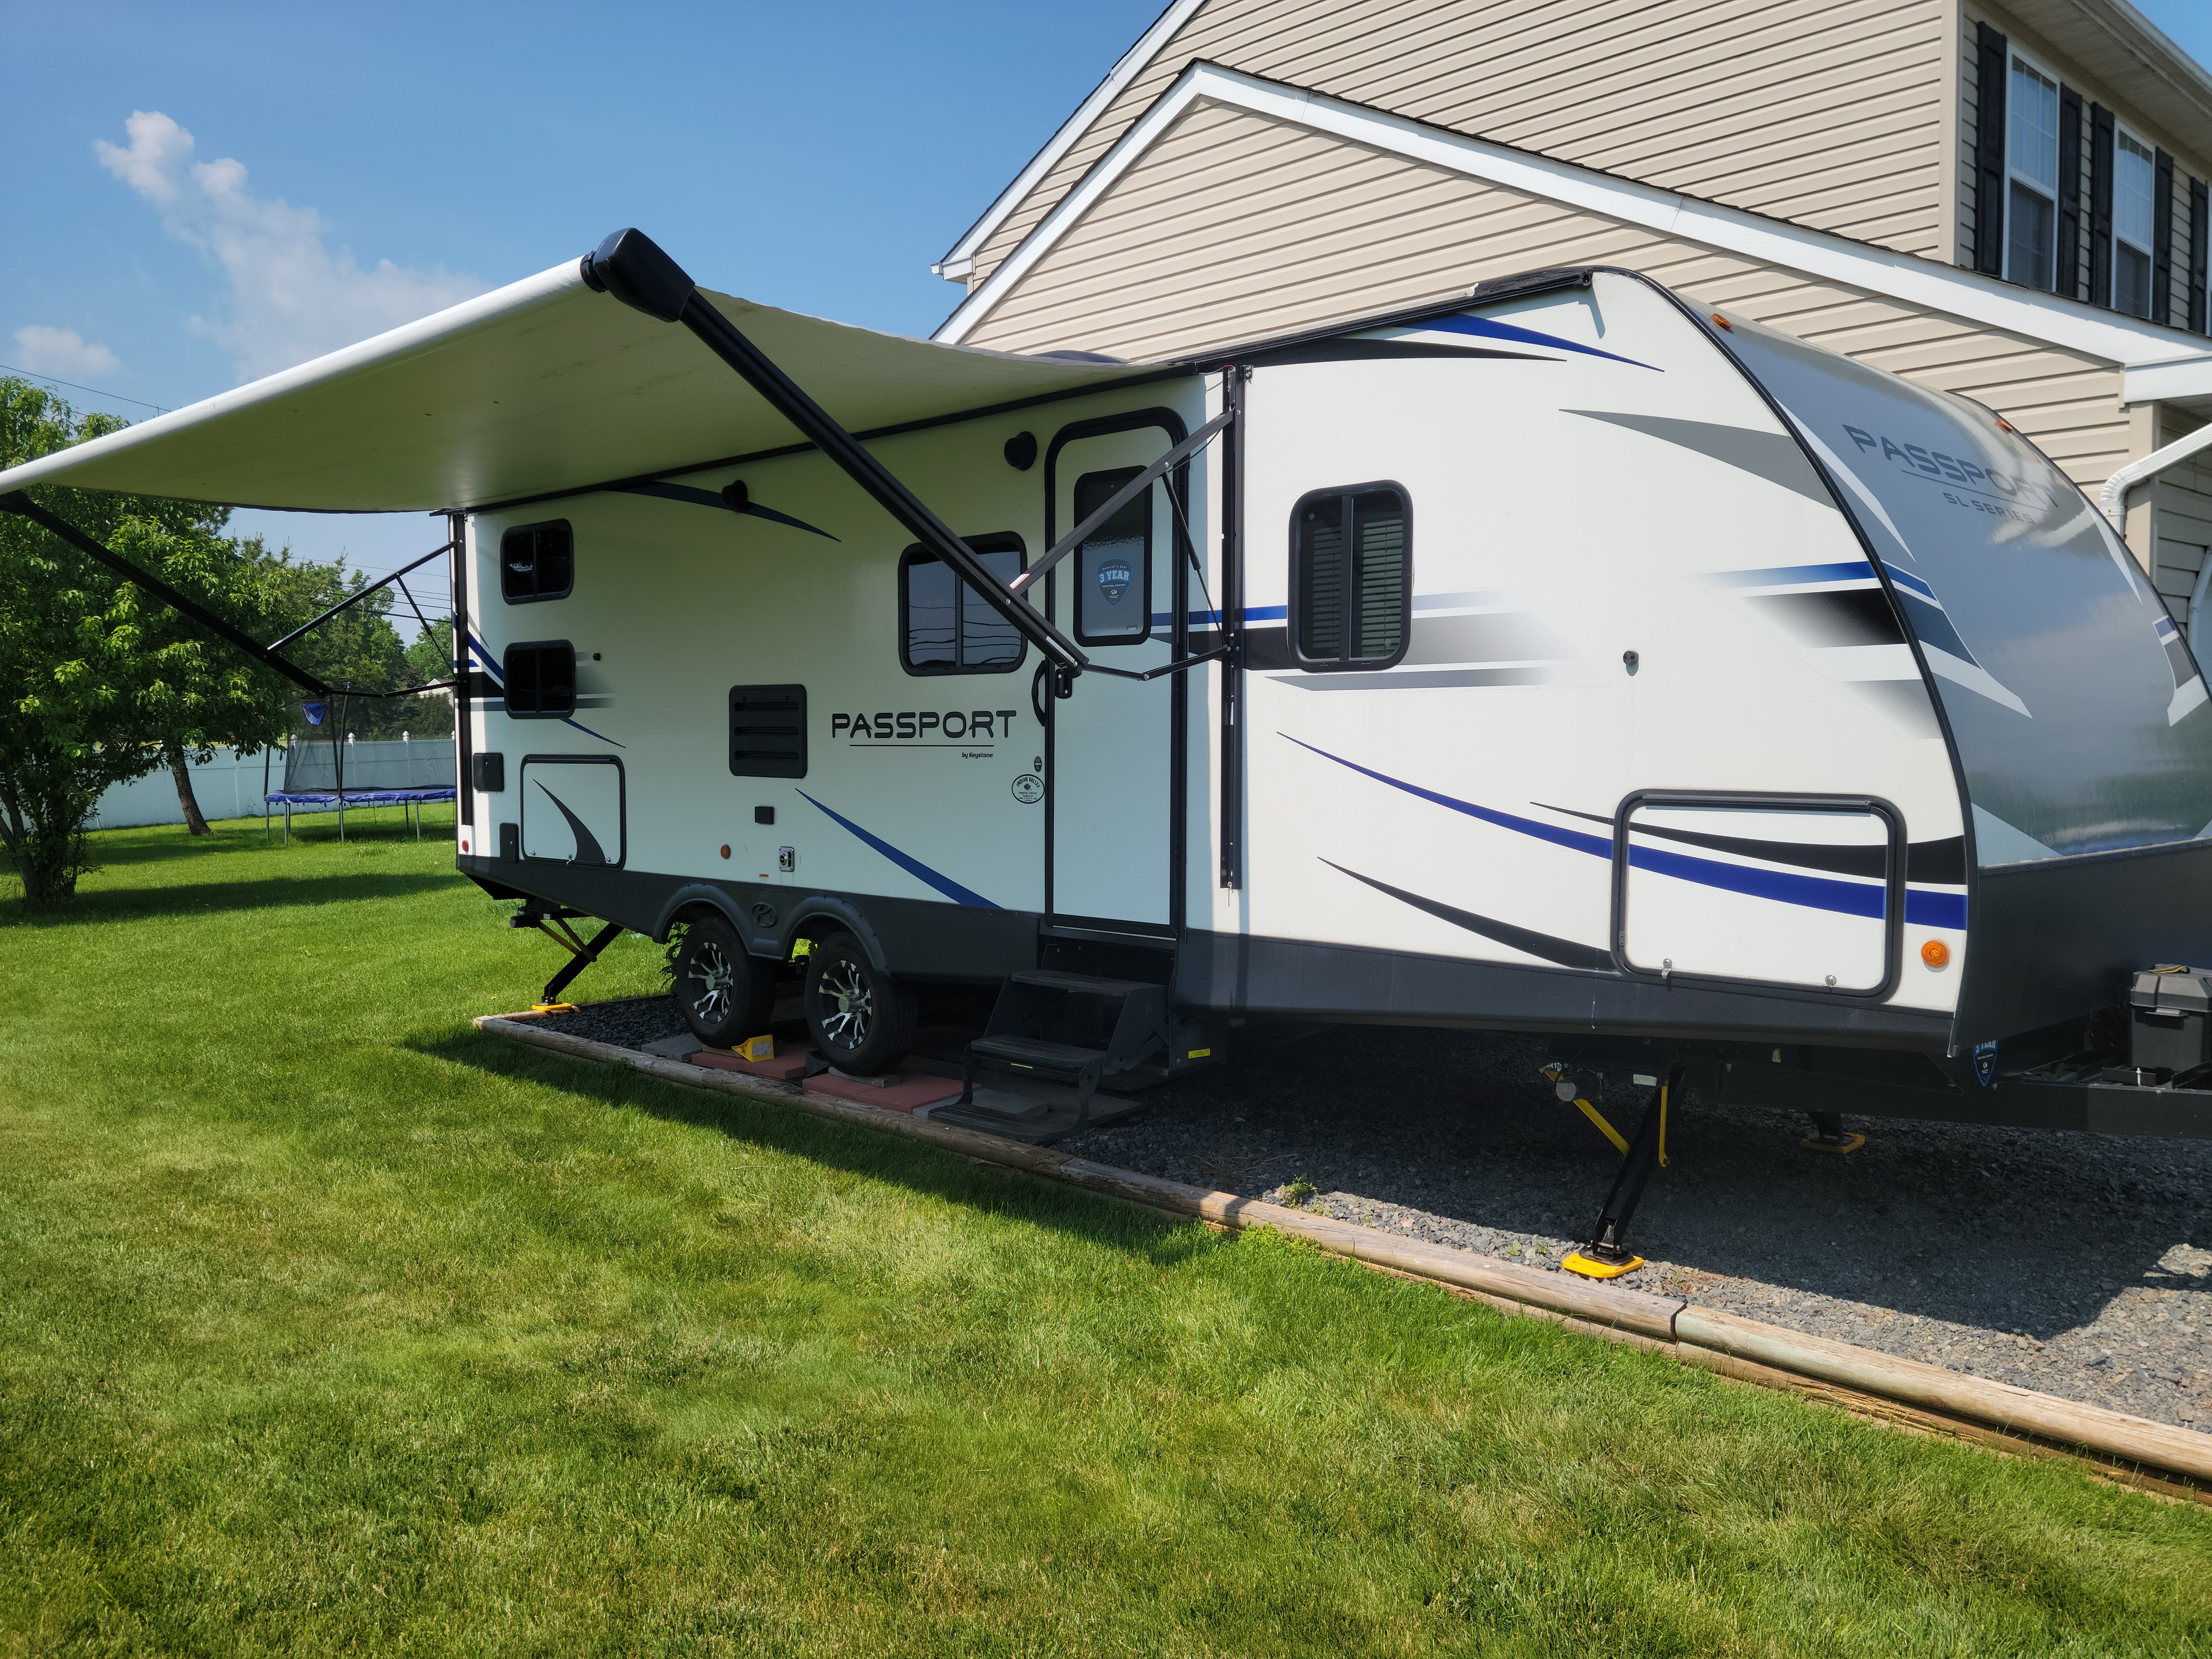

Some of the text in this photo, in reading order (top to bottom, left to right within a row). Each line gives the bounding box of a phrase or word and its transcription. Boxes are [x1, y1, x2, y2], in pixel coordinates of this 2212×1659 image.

[1842, 424, 2058, 508] PASSPORT
[1943, 492, 2036, 525] SL SERIES
[1099, 570, 1129, 582] 3 YEAR
[832, 710, 1016, 739] PASSPORT
[1016, 776, 1028, 787] INDIAN
[1029, 776, 1040, 788] VALLEY
